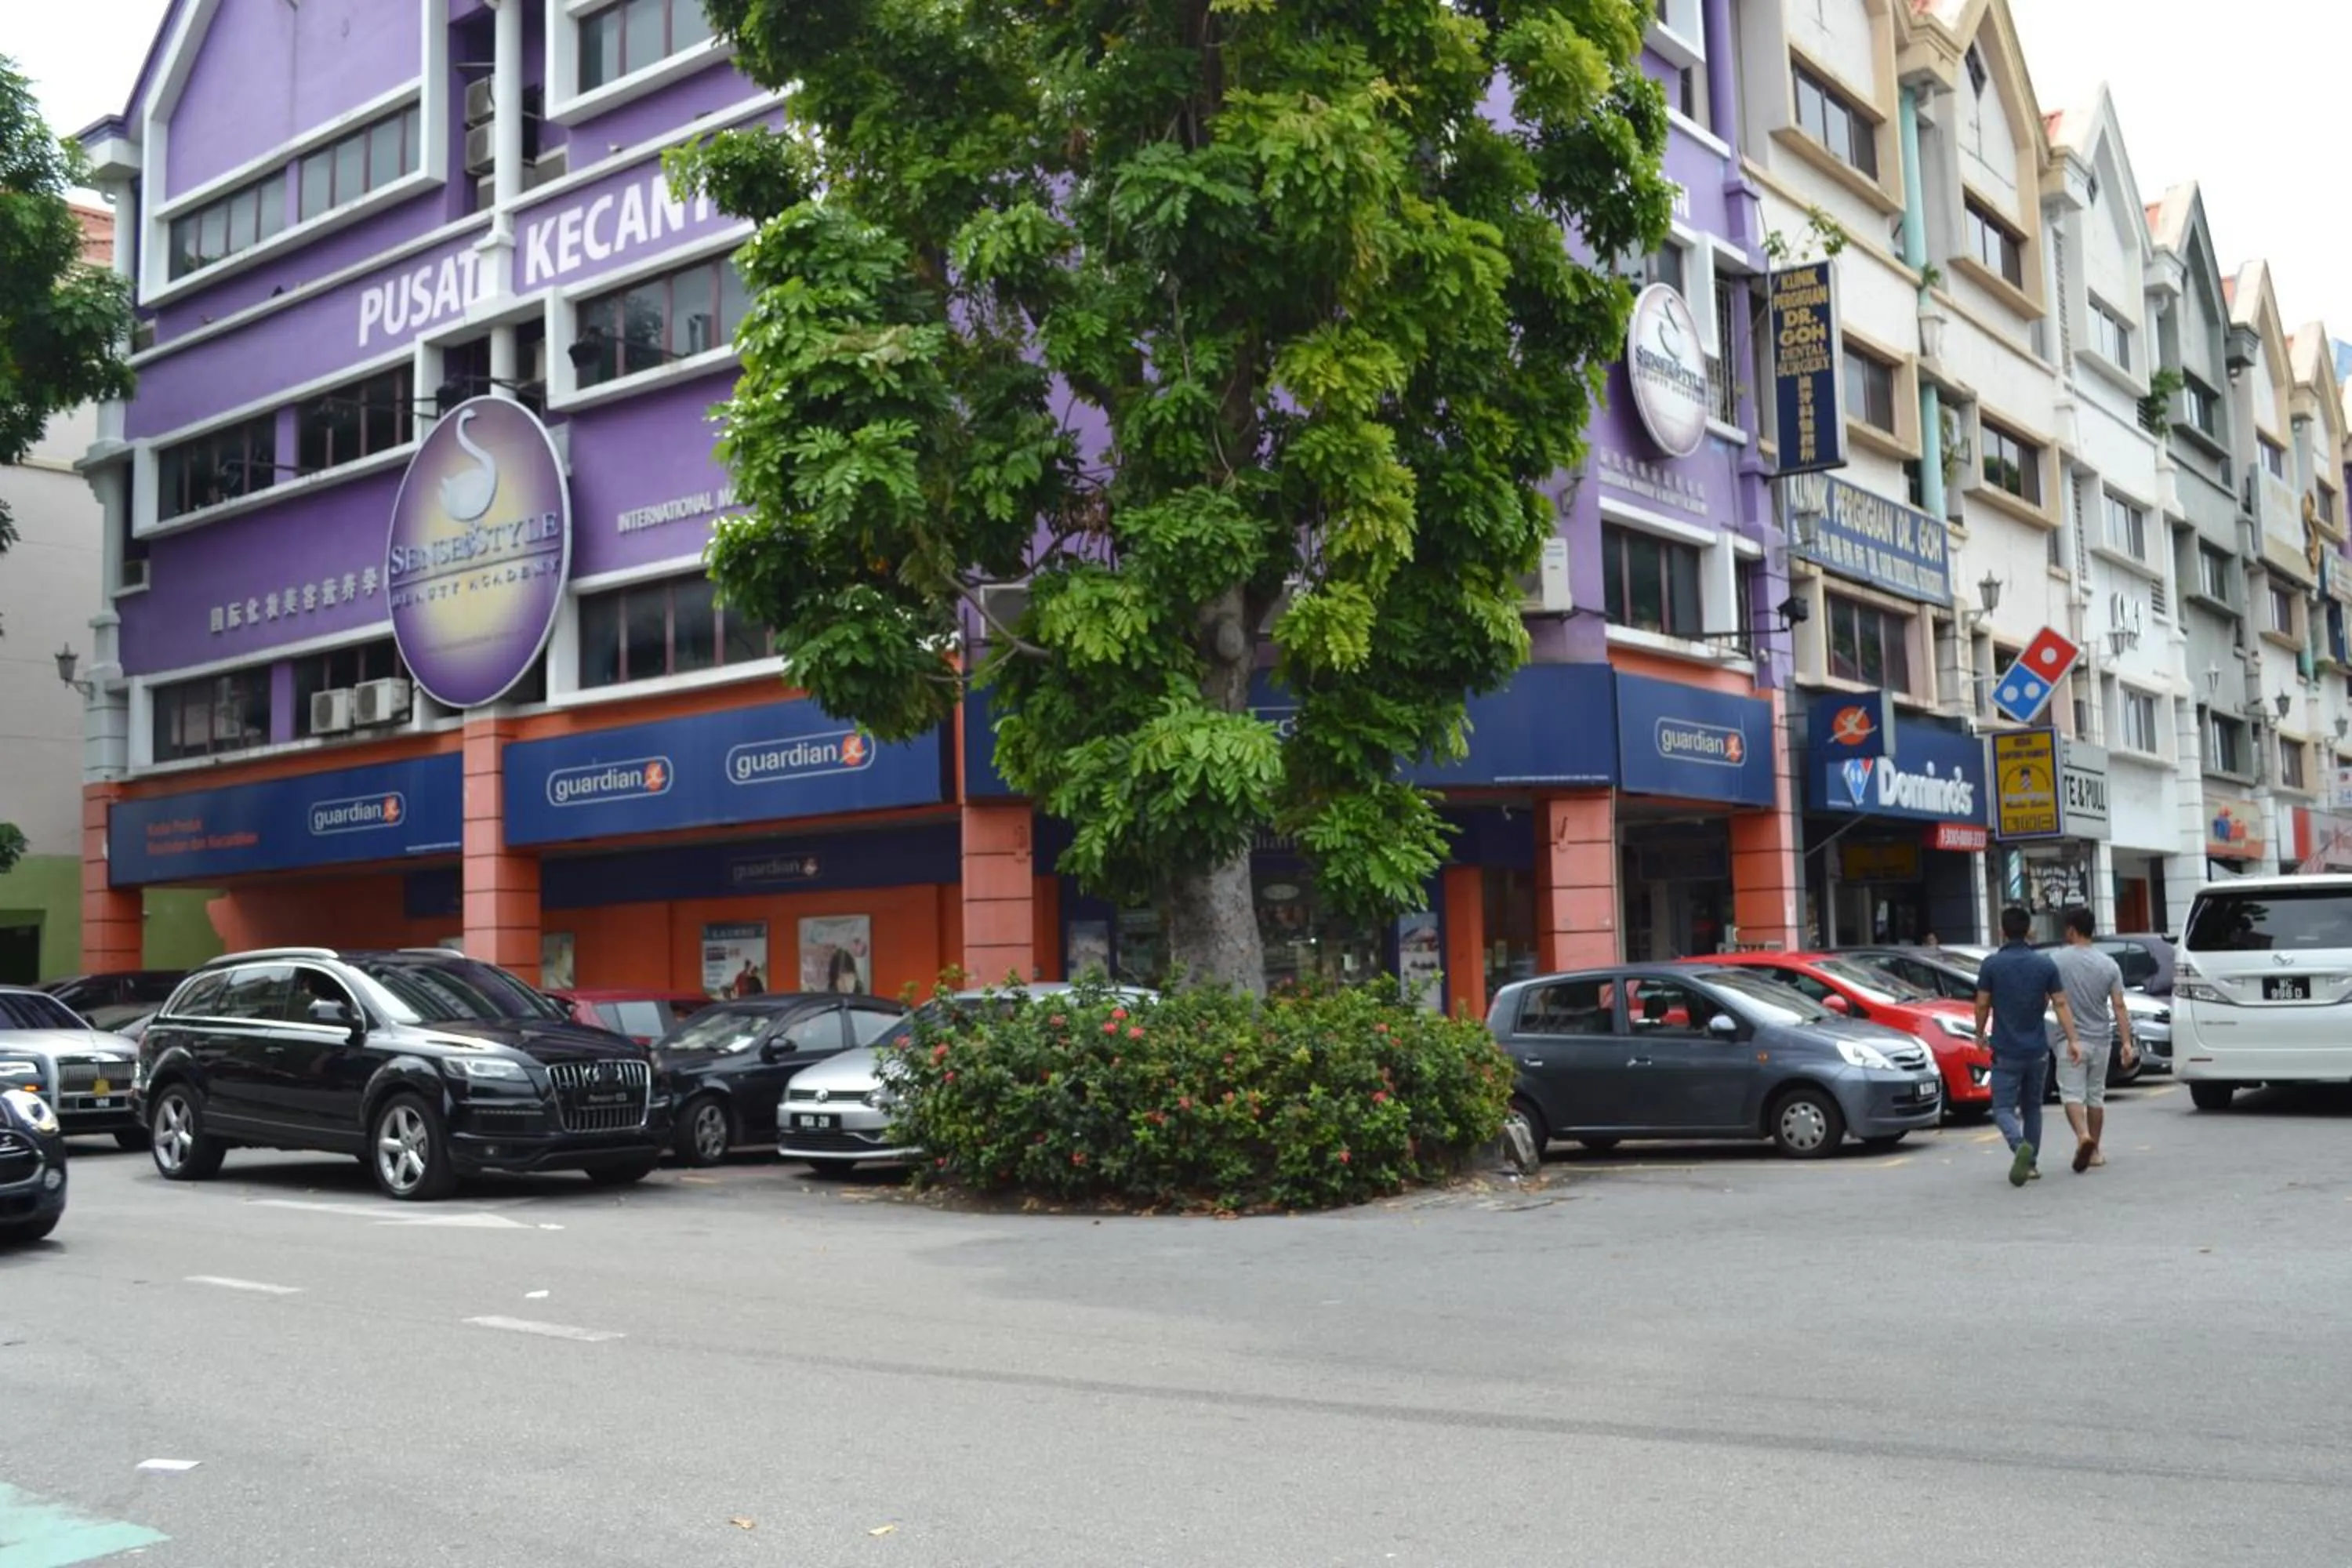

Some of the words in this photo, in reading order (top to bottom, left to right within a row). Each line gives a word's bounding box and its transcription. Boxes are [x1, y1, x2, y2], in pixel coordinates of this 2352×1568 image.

[358, 249, 481, 347] PUSAT
[1784, 307, 1818, 326] DR.
[1780, 324, 1825, 346] GOH
[618, 492, 713, 531] INTERNATIONAL
[1918, 517, 1943, 564] GOH
[1661, 728, 1724, 753] guardian
[737, 742, 837, 779] guardian
[556, 765, 641, 801] guardian
[1877, 756, 1974, 815] Domino's
[314, 801, 381, 829] guardian
[733, 859, 800, 881] guardian
